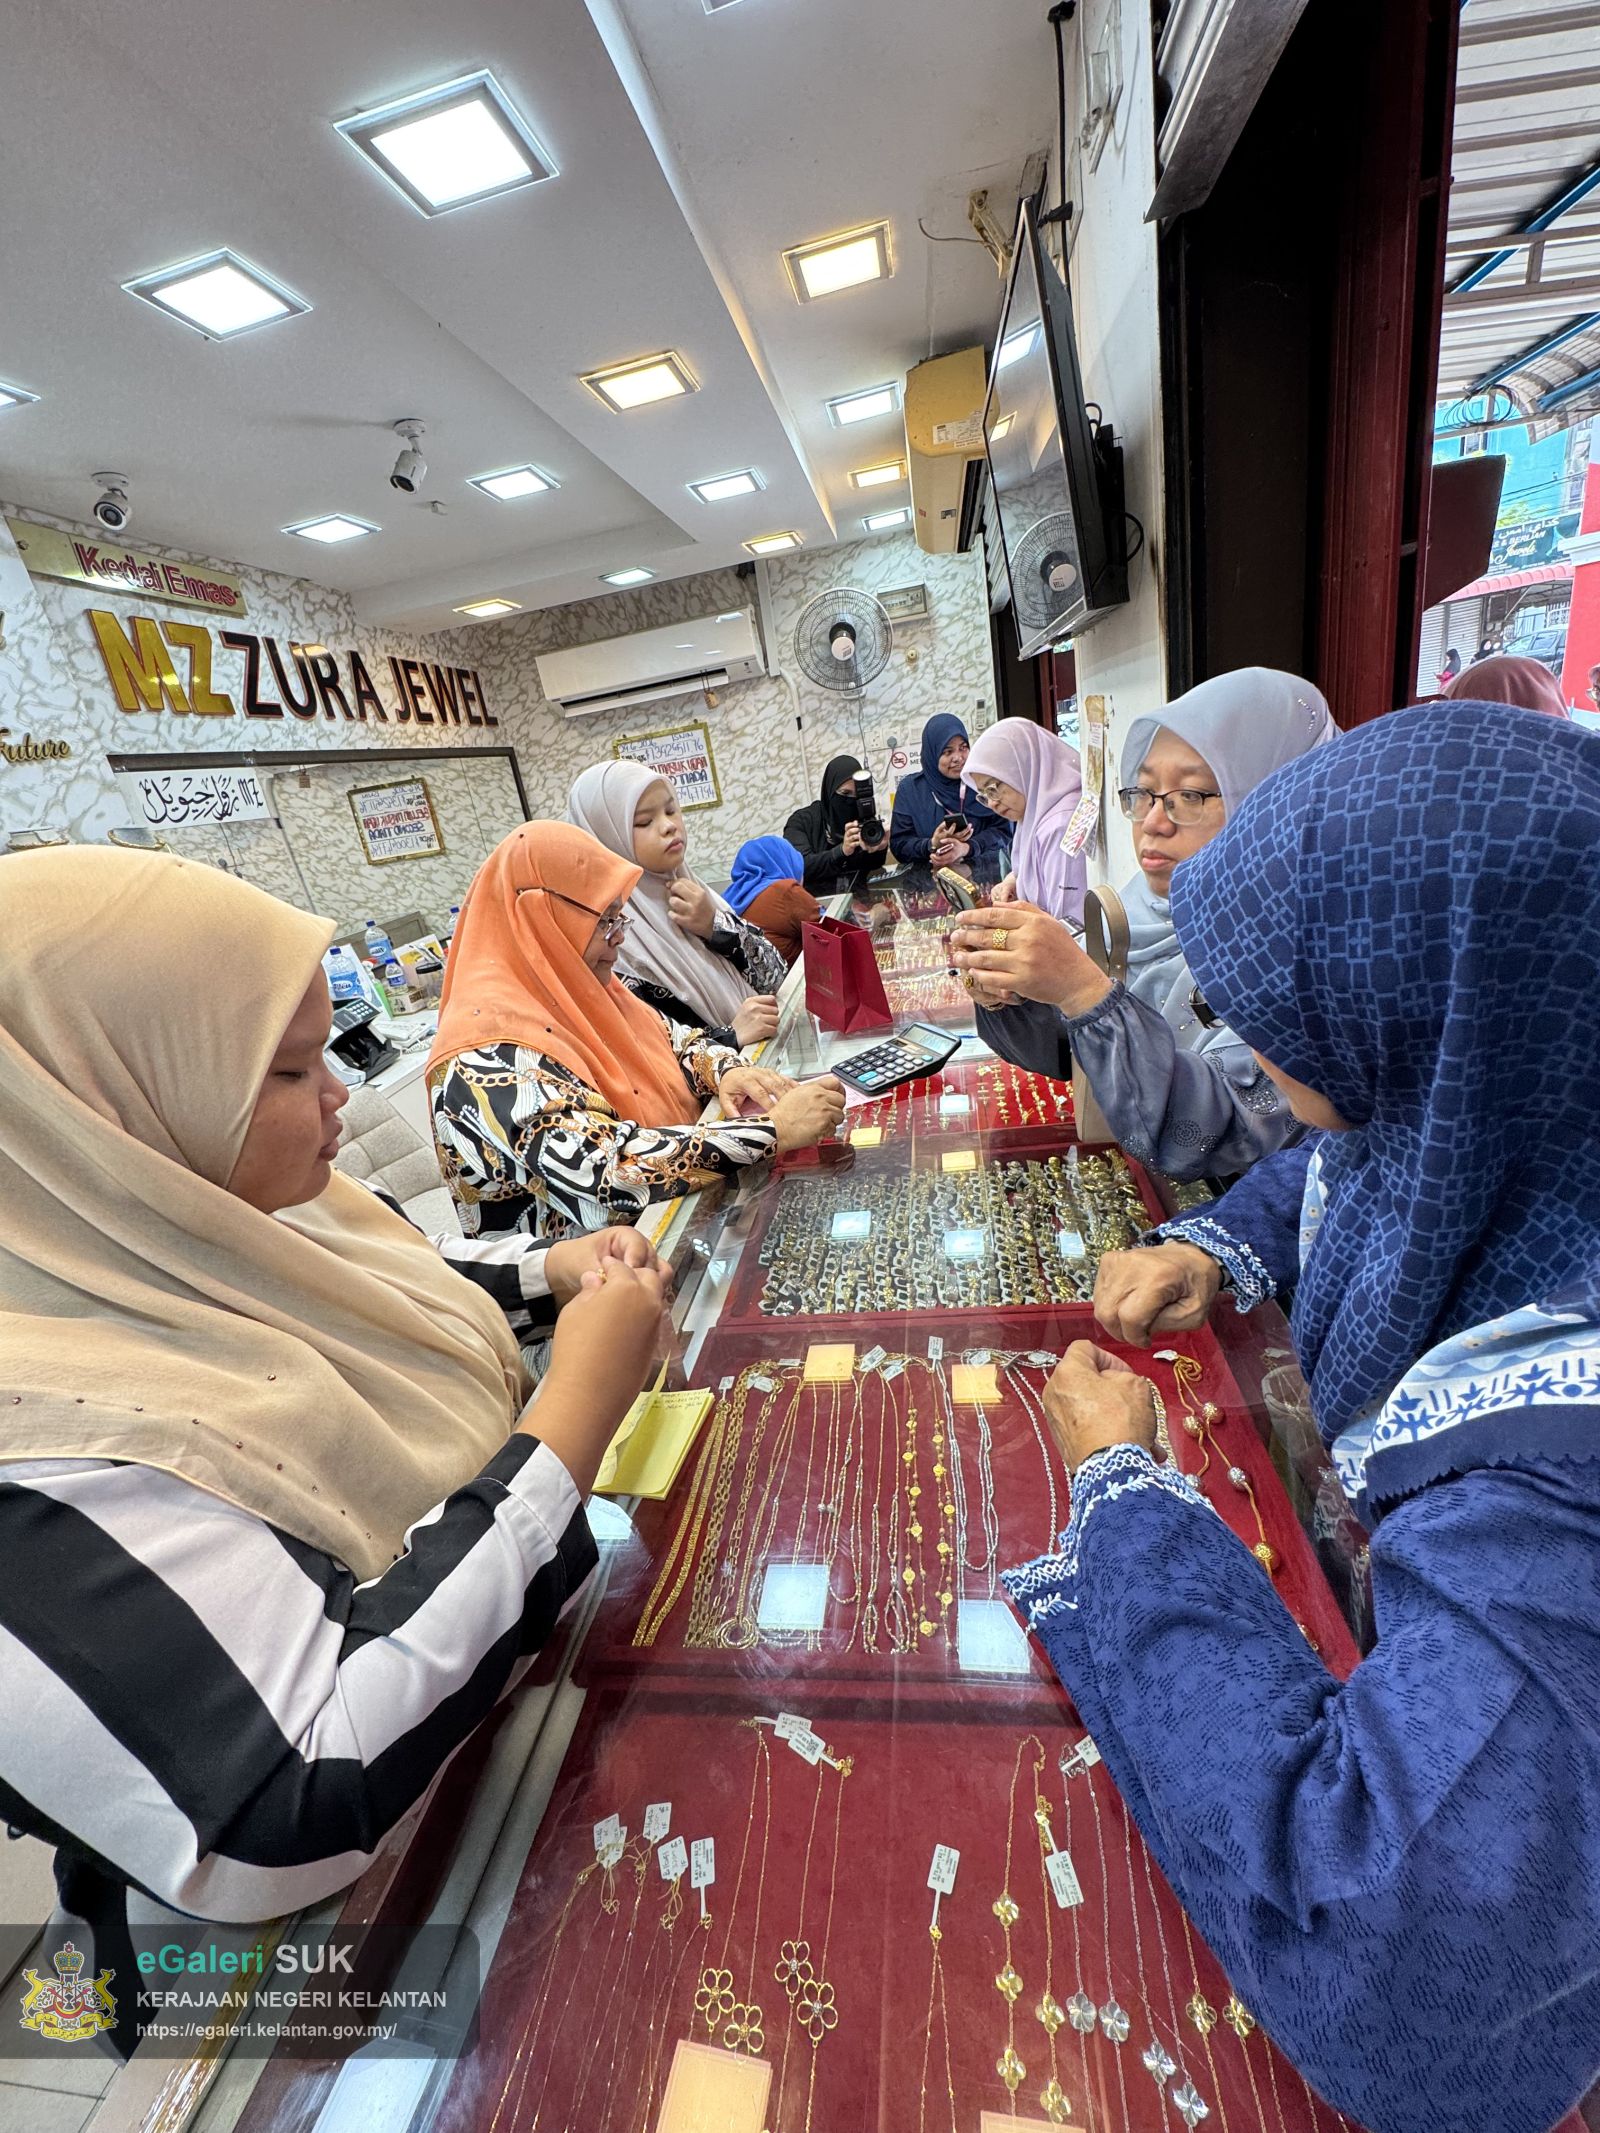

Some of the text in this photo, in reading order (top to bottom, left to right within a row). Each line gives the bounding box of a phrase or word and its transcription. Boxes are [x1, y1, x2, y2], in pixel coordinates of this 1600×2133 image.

[74, 542, 238, 607] Kedai Emas
[219, 630, 389, 722] ZURA
[387, 656, 499, 727] JEWEL
[680, 769, 708, 786] TIADA
